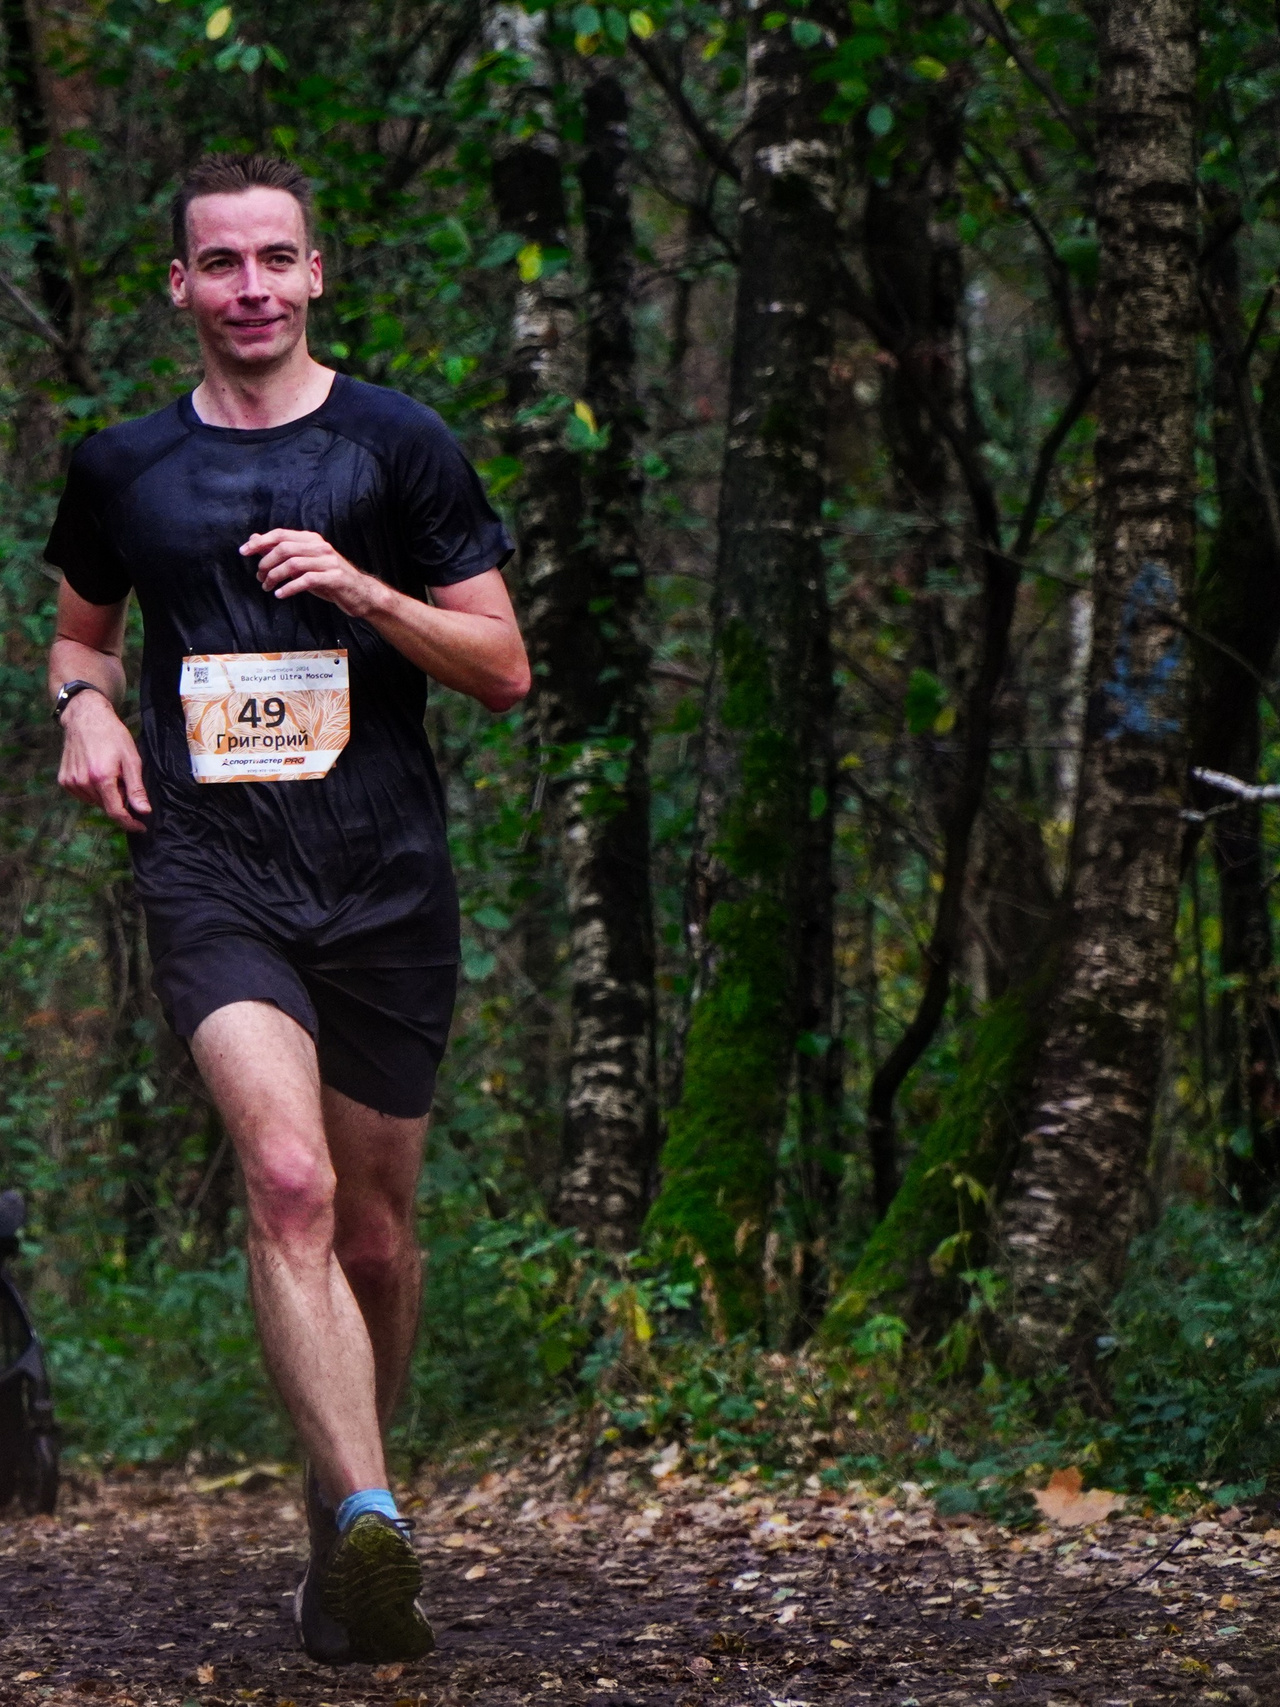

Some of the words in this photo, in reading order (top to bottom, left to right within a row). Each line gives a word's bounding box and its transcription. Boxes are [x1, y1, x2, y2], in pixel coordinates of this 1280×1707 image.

[240, 674, 277, 683] Backyard
[280, 673, 303, 681] Ultra
[305, 672, 334, 680] Moscow
[237, 697, 286, 729] 49
[216, 730, 309, 752] Григорий
[283, 756, 306, 766] PRO
